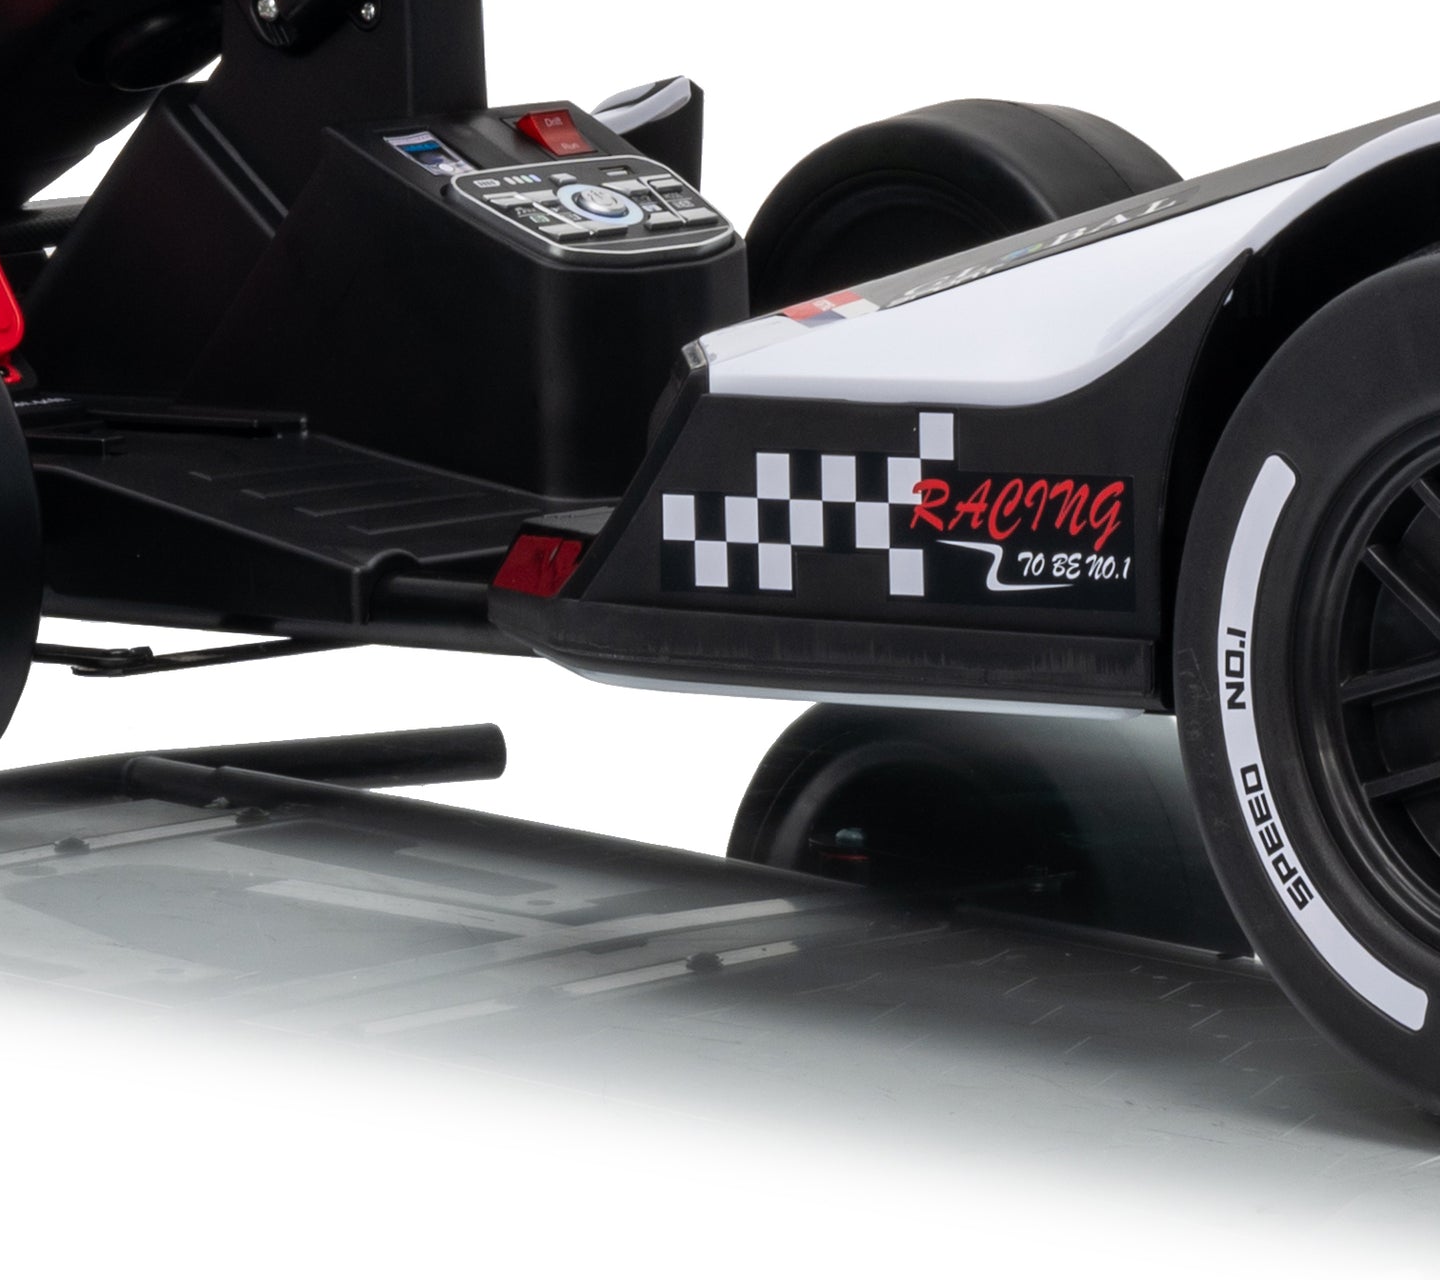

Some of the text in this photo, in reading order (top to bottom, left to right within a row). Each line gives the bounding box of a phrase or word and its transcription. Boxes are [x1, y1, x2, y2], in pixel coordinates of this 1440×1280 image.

[544, 116, 563, 127] Drift
[561, 142, 580, 150] Run
[910, 477, 1125, 552] RACING
[1017, 551, 1131, 580] TO BE NO.1
[1224, 627, 1314, 911] SPEED NO.1
